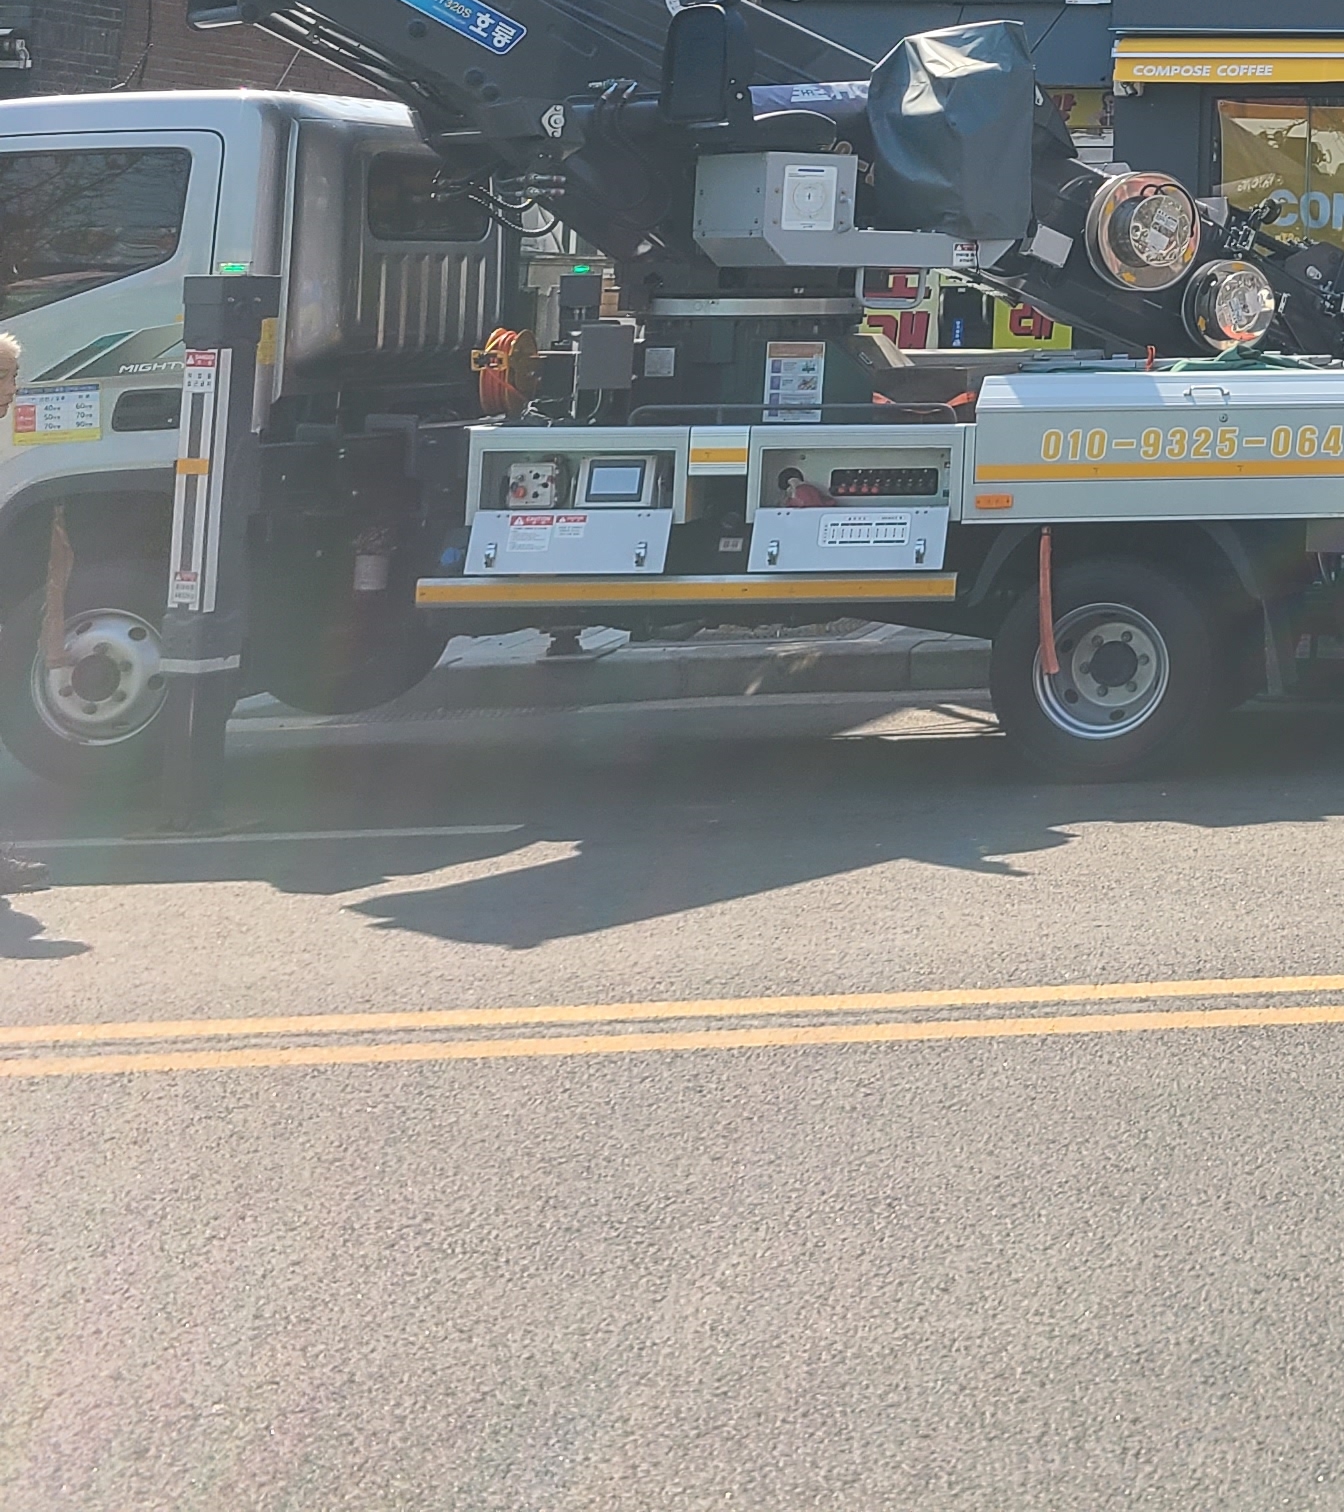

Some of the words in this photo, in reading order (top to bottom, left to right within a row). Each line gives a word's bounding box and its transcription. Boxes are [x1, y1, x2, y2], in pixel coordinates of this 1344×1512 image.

[469, 10, 517, 48] 호룡
[1133, 64, 1211, 77] COMPOSE
[1216, 64, 1274, 77] COFFEE
